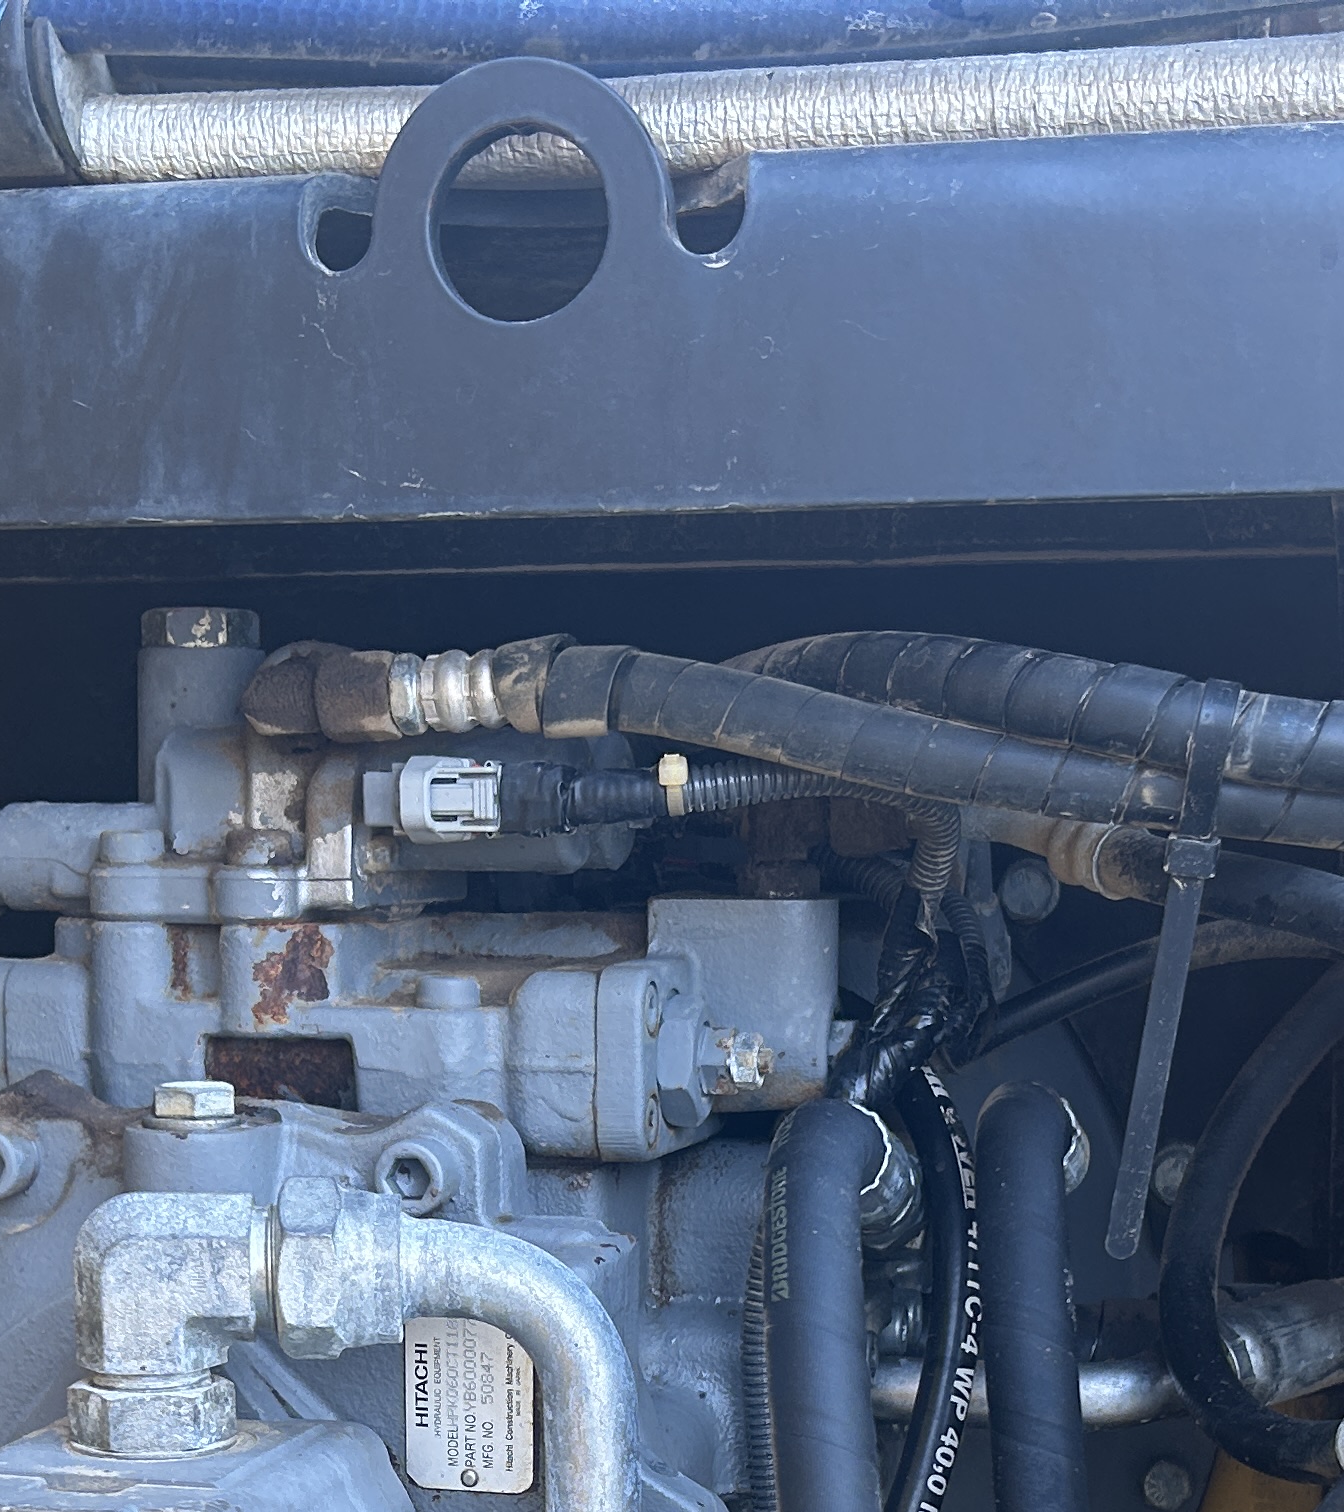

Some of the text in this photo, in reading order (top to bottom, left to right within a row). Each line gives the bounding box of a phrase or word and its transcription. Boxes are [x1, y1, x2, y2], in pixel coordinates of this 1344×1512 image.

[770, 1166, 790, 1302] BRIDGESTONE
[414, 1342, 429, 1428] HITACHI
[433, 1336, 442, 1438] HYDRAULIC EQUIPMENT
[505, 1343, 516, 1386] Machinery
[480, 1352, 494, 1469] MFG. NO. 50847
[505, 1388, 514, 1441] Construction
[950, 1367, 975, 1422] WP
[447, 1426, 459, 1467] MODEL
[464, 1411, 477, 1433] NO.
[464, 1436, 477, 1468] PART
[505, 1444, 514, 1472] Hitachi
[926, 1426, 959, 1497] 40,0
